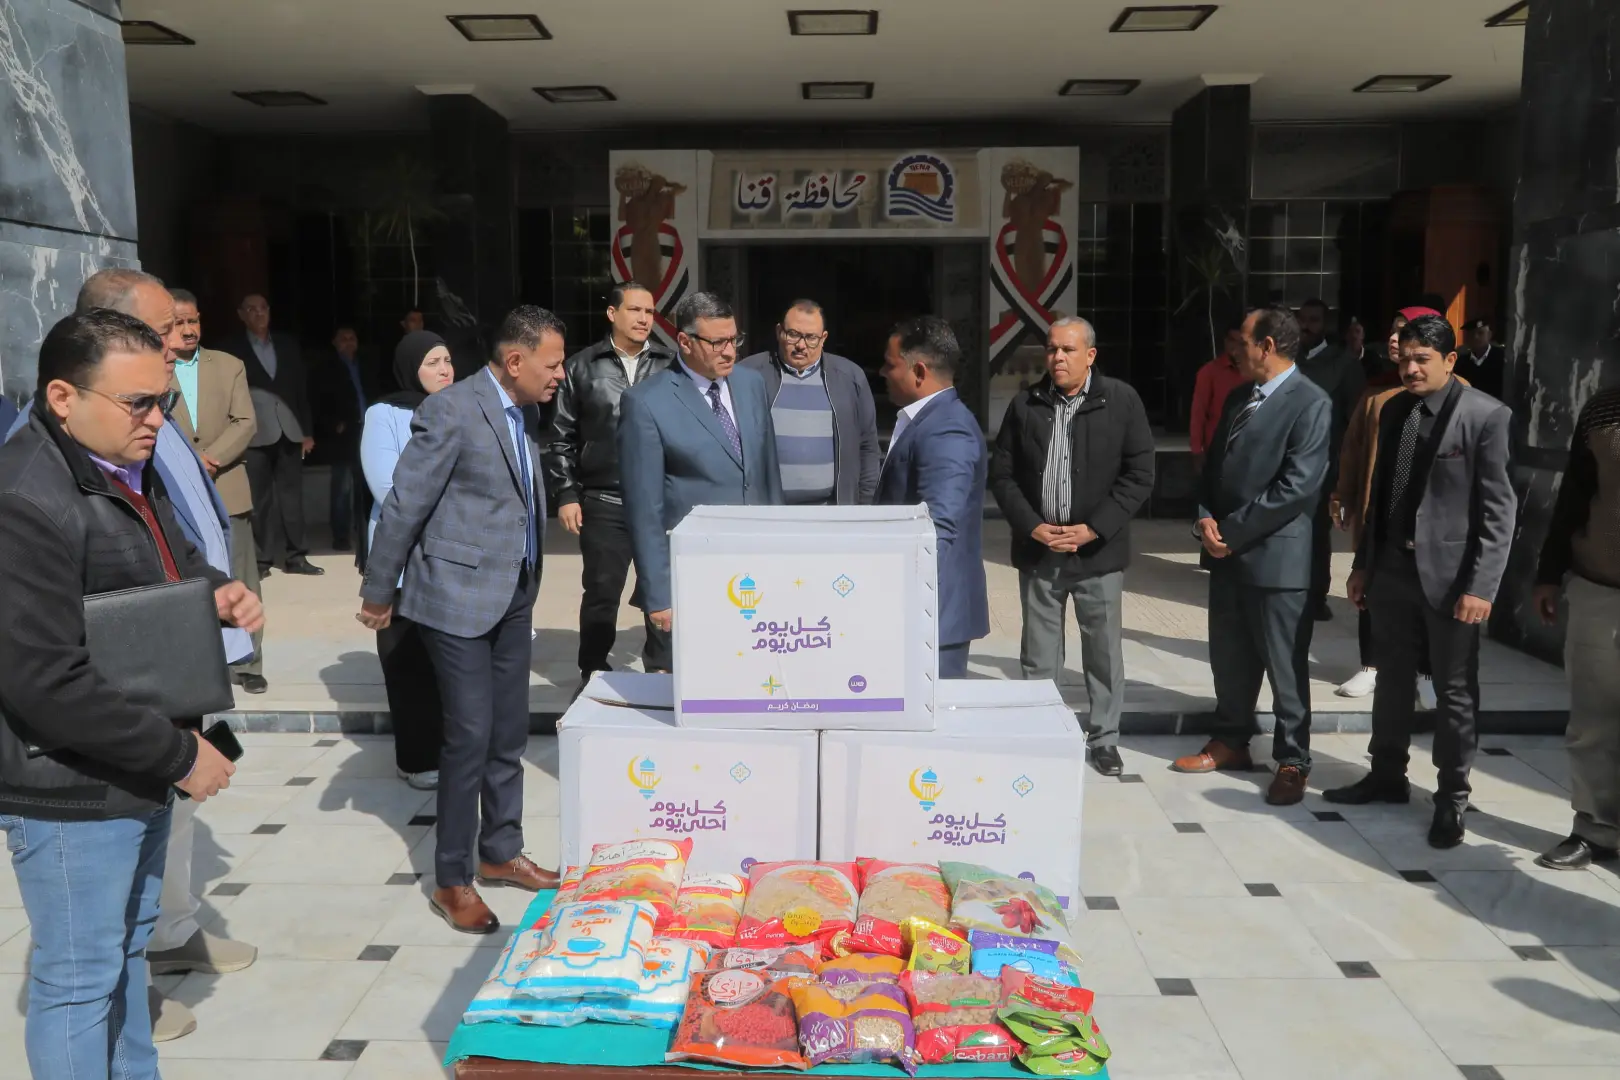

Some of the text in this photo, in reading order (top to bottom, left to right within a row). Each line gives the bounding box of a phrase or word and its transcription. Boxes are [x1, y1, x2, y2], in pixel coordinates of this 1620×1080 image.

[738, 173, 866, 213] محافظة قنا
[752, 616, 831, 637] كل يوم
[752, 632, 831, 654] أحلى يوم
[767, 702, 819, 710] رمضان كريم
[649, 799, 727, 818] كل يوم
[649, 815, 727, 833] أحلى يوم
[928, 812, 1007, 830] كل يوم
[927, 829, 1006, 846] أحلى يوم
